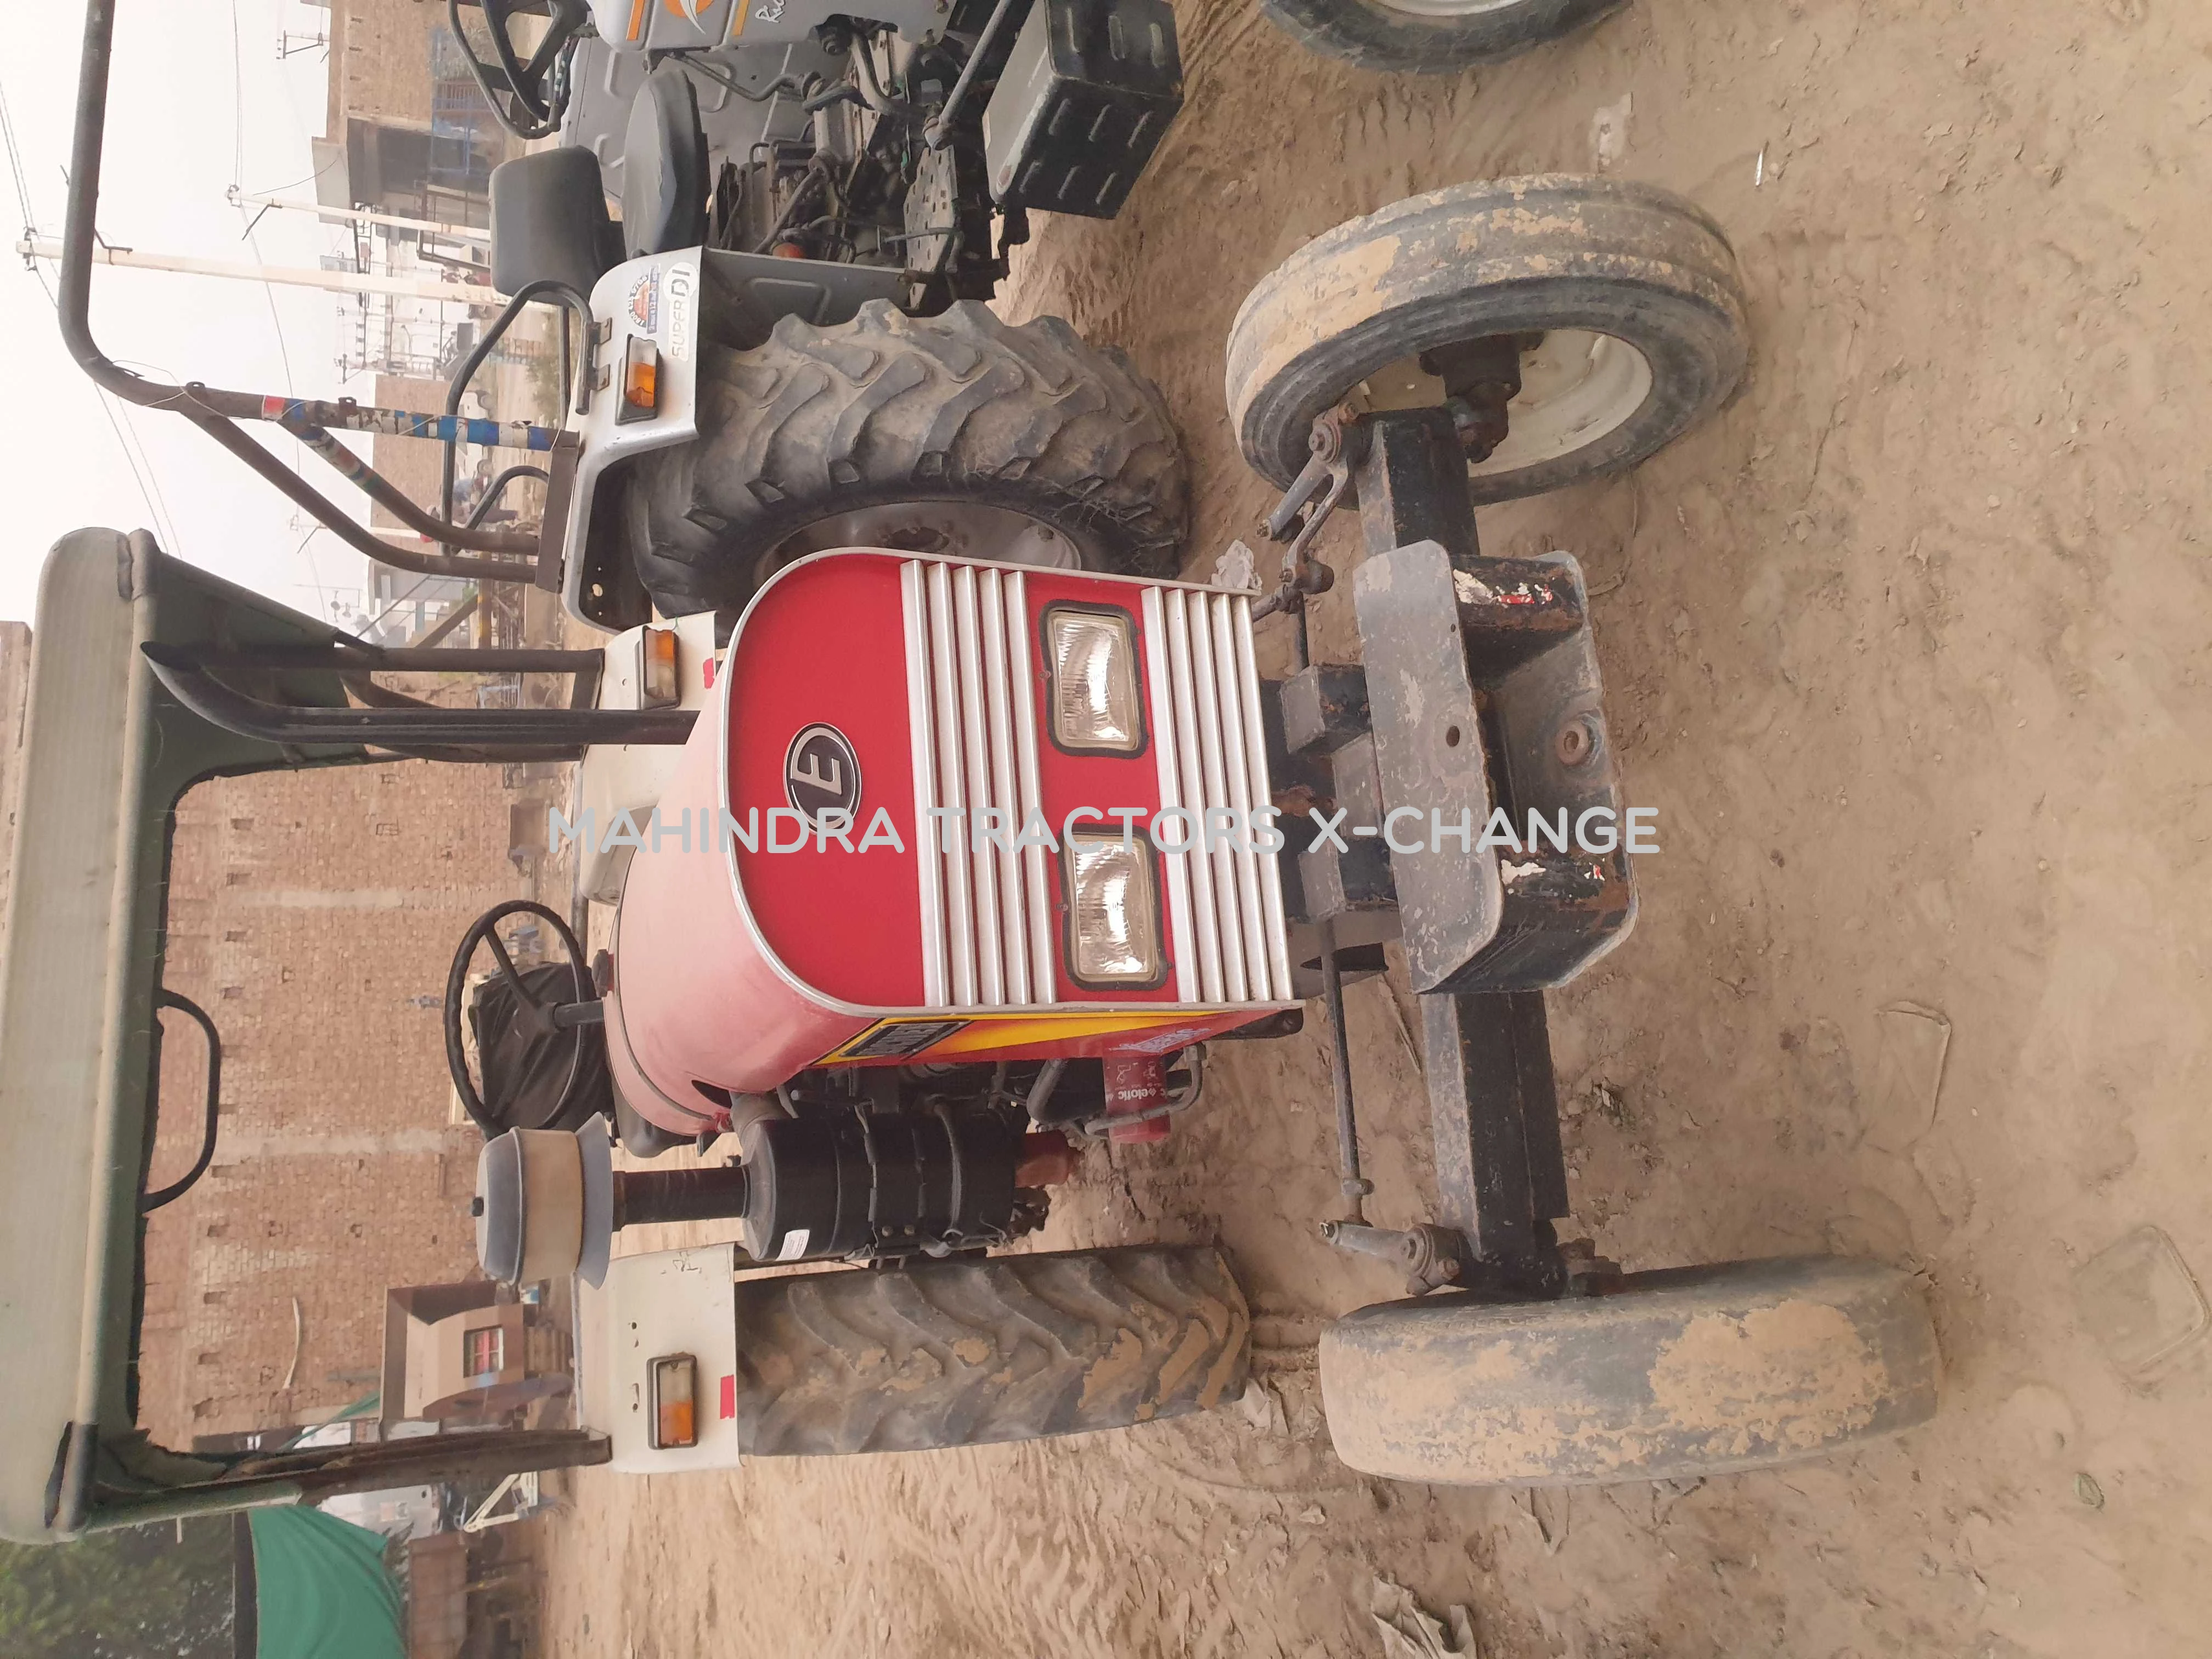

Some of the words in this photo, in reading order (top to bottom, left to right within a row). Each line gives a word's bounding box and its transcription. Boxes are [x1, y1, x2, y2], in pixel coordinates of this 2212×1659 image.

[671, 269, 690, 297] DI
[672, 300, 685, 357] SUPER
[1118, 1089, 1148, 1101] elofic
